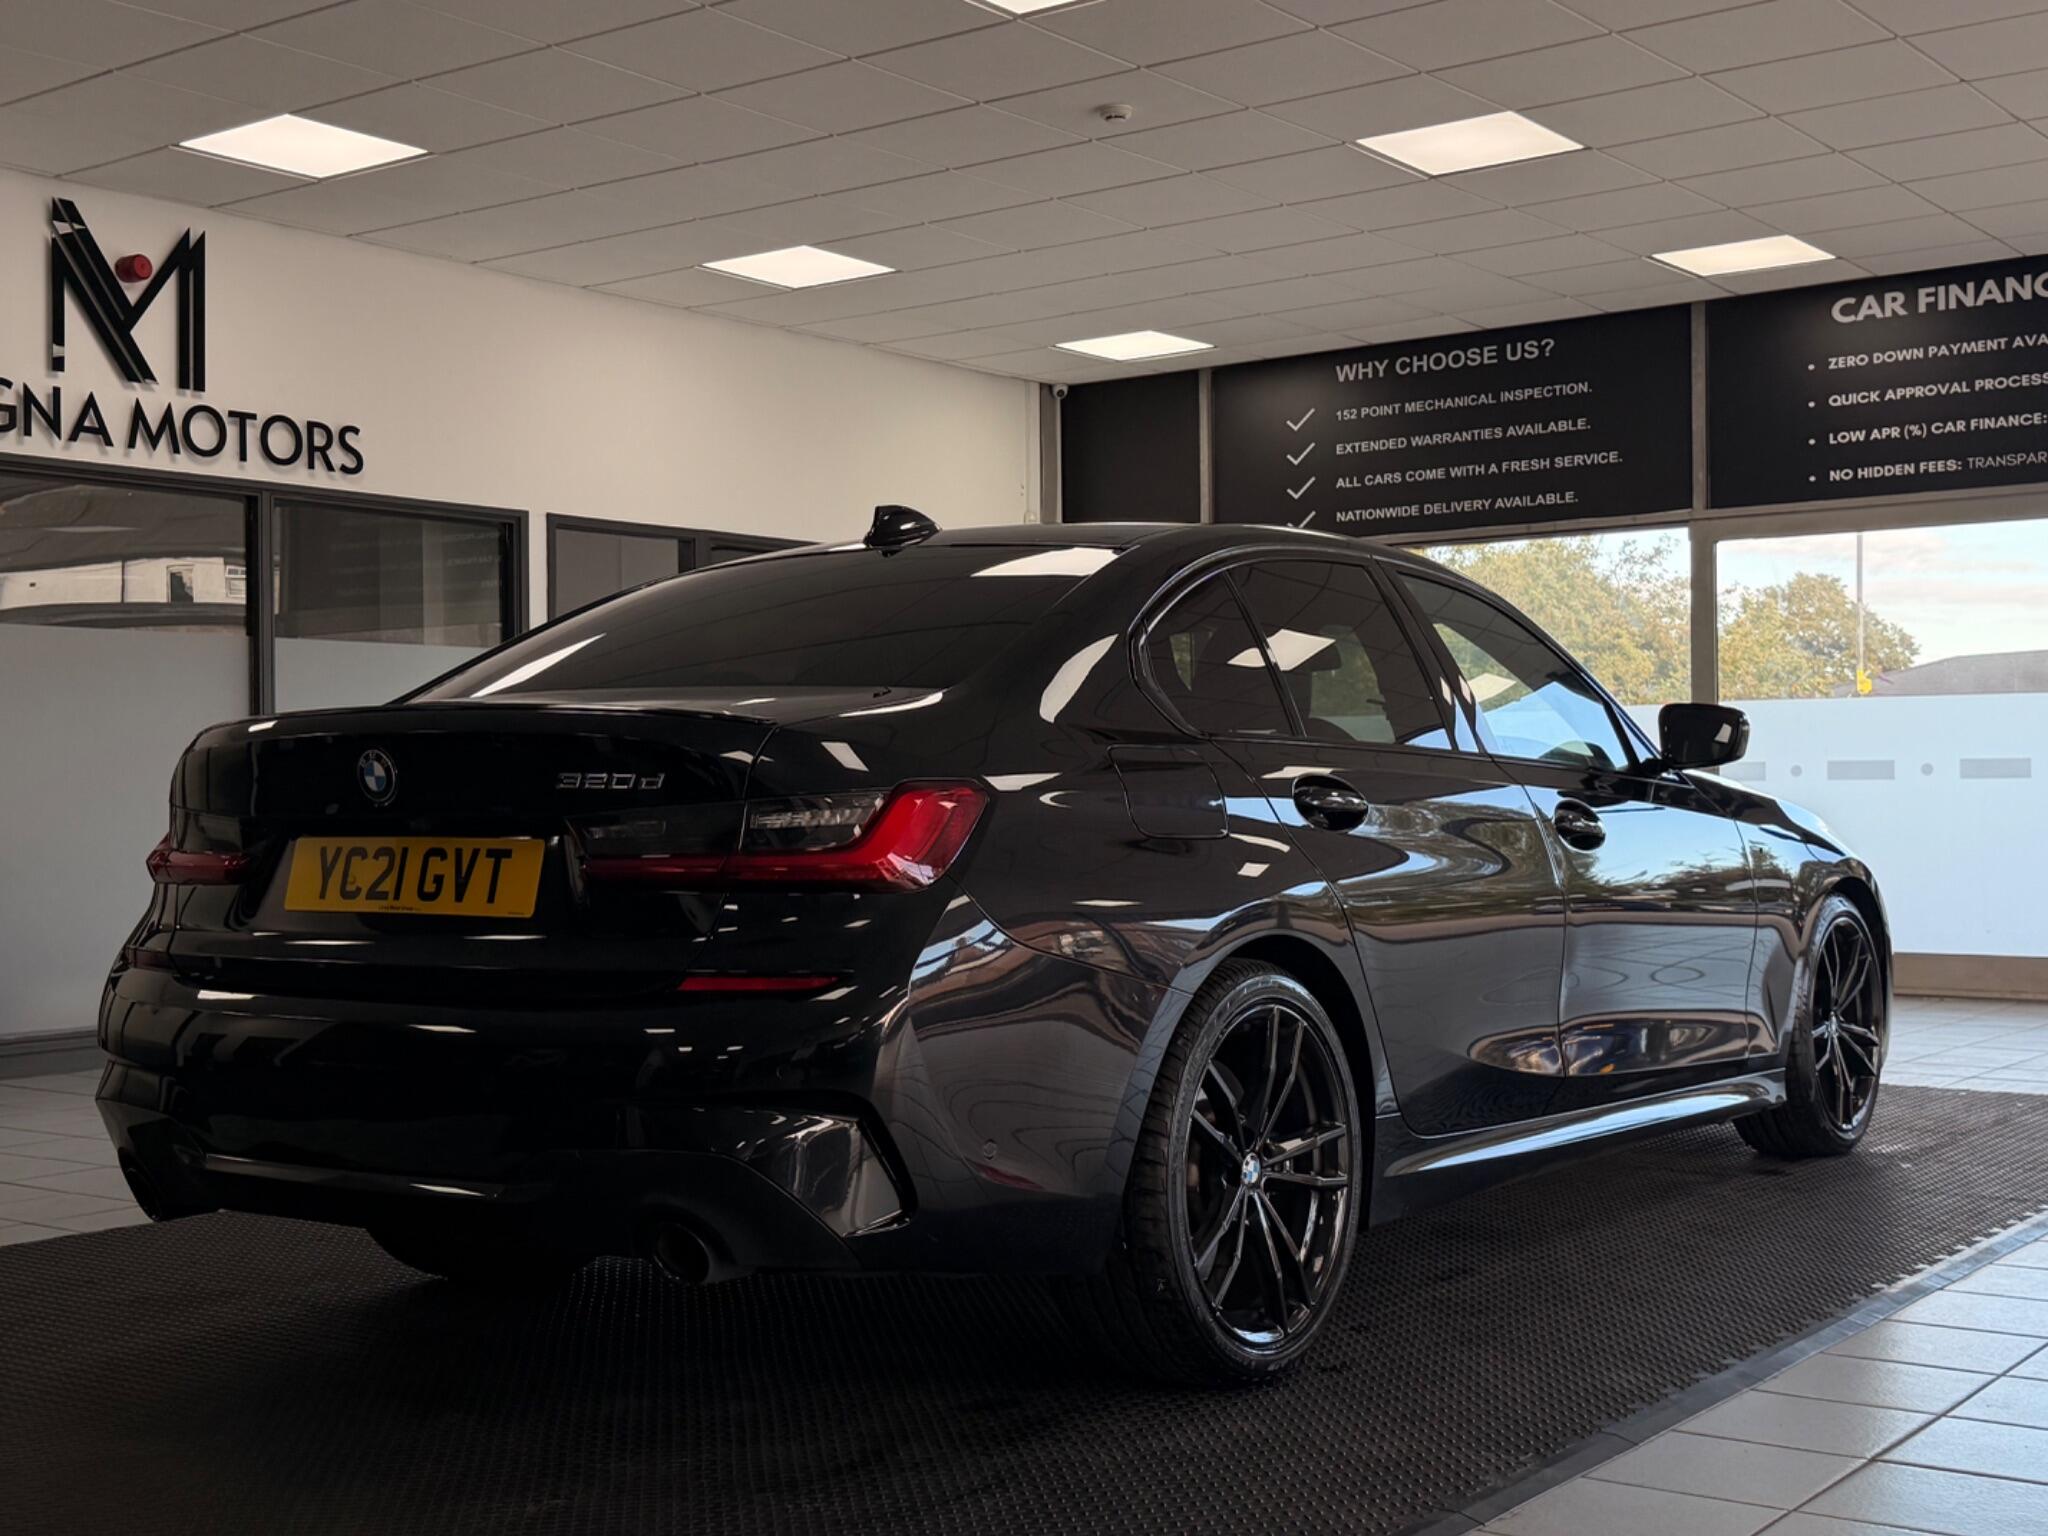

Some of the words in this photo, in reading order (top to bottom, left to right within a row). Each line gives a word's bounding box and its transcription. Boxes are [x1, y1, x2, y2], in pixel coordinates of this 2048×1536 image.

[1831, 291, 1908, 324] CAR
[1336, 359, 1389, 383] WHY
[1395, 345, 1498, 376] CHOOSE
[1506, 338, 1555, 362] US?
[1828, 354, 1869, 370] ZERO
[1873, 347, 1924, 365] DOWN
[1929, 337, 2008, 358] PAYMENT
[1336, 409, 1358, 421] 152
[1360, 403, 1401, 419] POINT
[1405, 392, 1497, 413] MECHANICAL
[1500, 381, 1593, 403] INSPECTION.
[1828, 389, 1881, 407] QUICK
[1884, 380, 1970, 401] APPROVAL
[127, 397, 364, 475] MOTORS
[1336, 437, 1407, 455] EXTENDED
[1410, 426, 1502, 447] WARRANTIES
[1506, 418, 1591, 437] AVAILABLE.
[1828, 430, 1866, 445] LOW
[1869, 426, 1900, 441] APR
[1904, 423, 1927, 440] (%)
[1931, 420, 1966, 434] CAR
[1970, 412, 2048, 431] FINANCE:
[1336, 475, 1362, 489] ALL
[1364, 471, 1402, 487] CARS
[1405, 467, 1447, 482] COME
[1449, 463, 1486, 478] WITH
[1488, 463, 1499, 475] A
[1502, 458, 1551, 473] FRESH
[1554, 450, 1623, 468] SERVICE.
[1829, 469, 1854, 482] NO
[1857, 461, 1916, 479] HIDDEN
[1920, 459, 1962, 474] FEES:
[1967, 451, 2048, 469] TRANSPAR
[1336, 504, 1421, 522] NATIONWIDE
[1423, 498, 1493, 515] DELIVERY
[1495, 490, 1579, 508] AVAILABLE.
[556, 772, 666, 790] 320d
